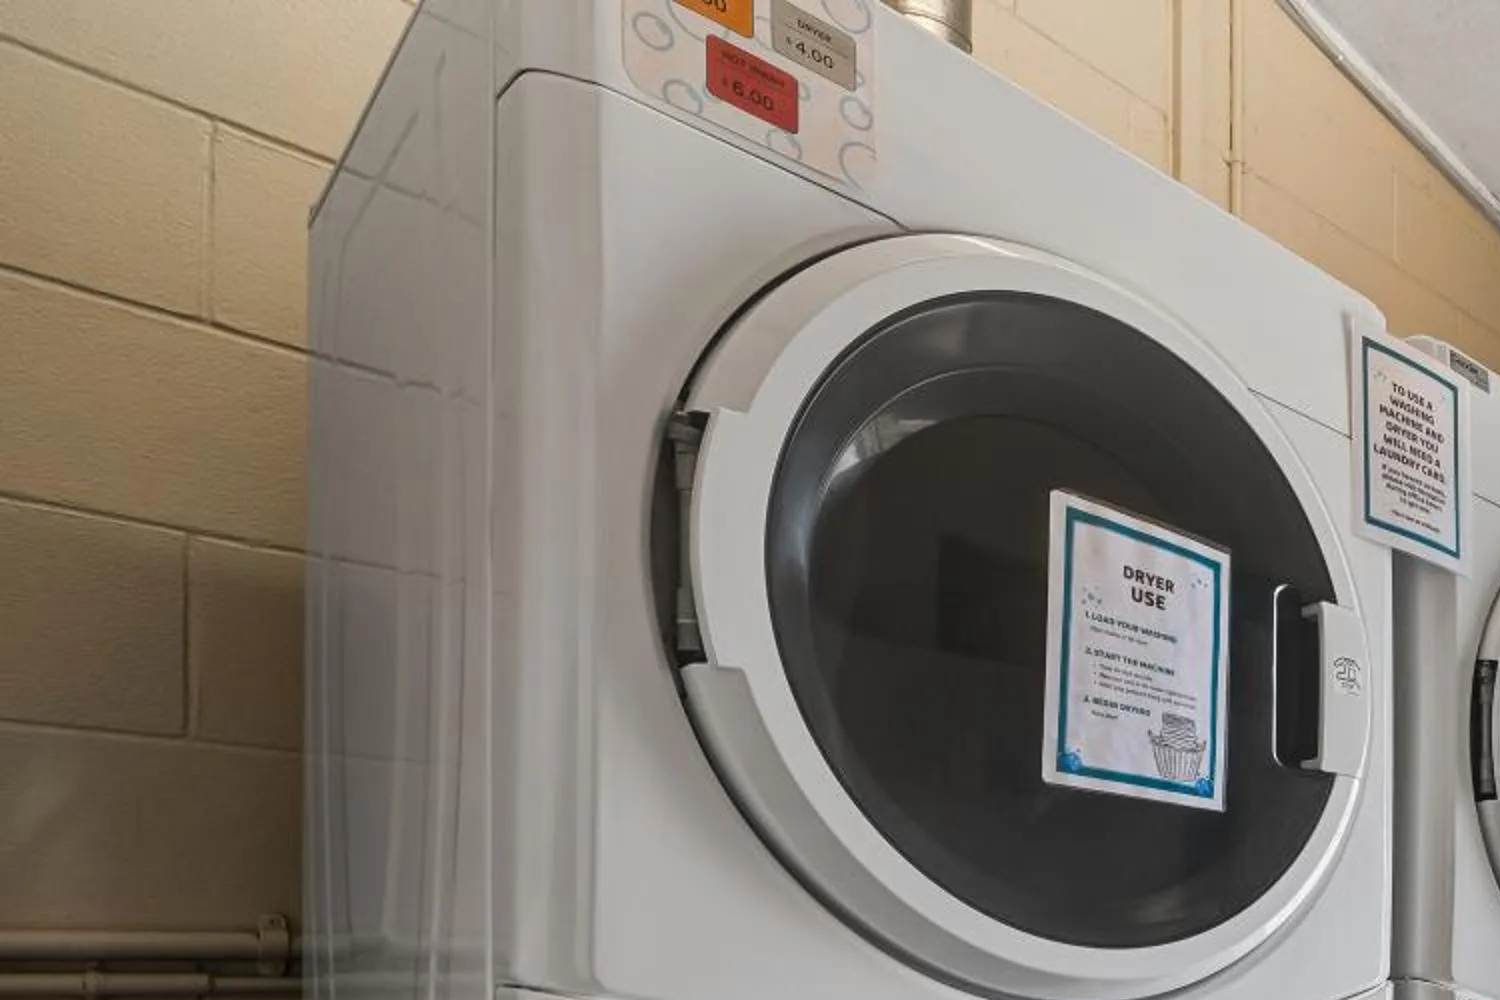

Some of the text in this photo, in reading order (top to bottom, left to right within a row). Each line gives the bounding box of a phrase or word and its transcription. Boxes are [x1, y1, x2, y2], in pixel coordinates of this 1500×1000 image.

[1392, 382, 1405, 397] TO
[1407, 390, 1425, 407] USE
[1379, 403, 1423, 433] MACHINE
[1389, 395, 1435, 426] WASHING
[1420, 437, 1439, 454] YOU
[1123, 565, 1175, 594] DRYER
[1131, 586, 1167, 611] USE
